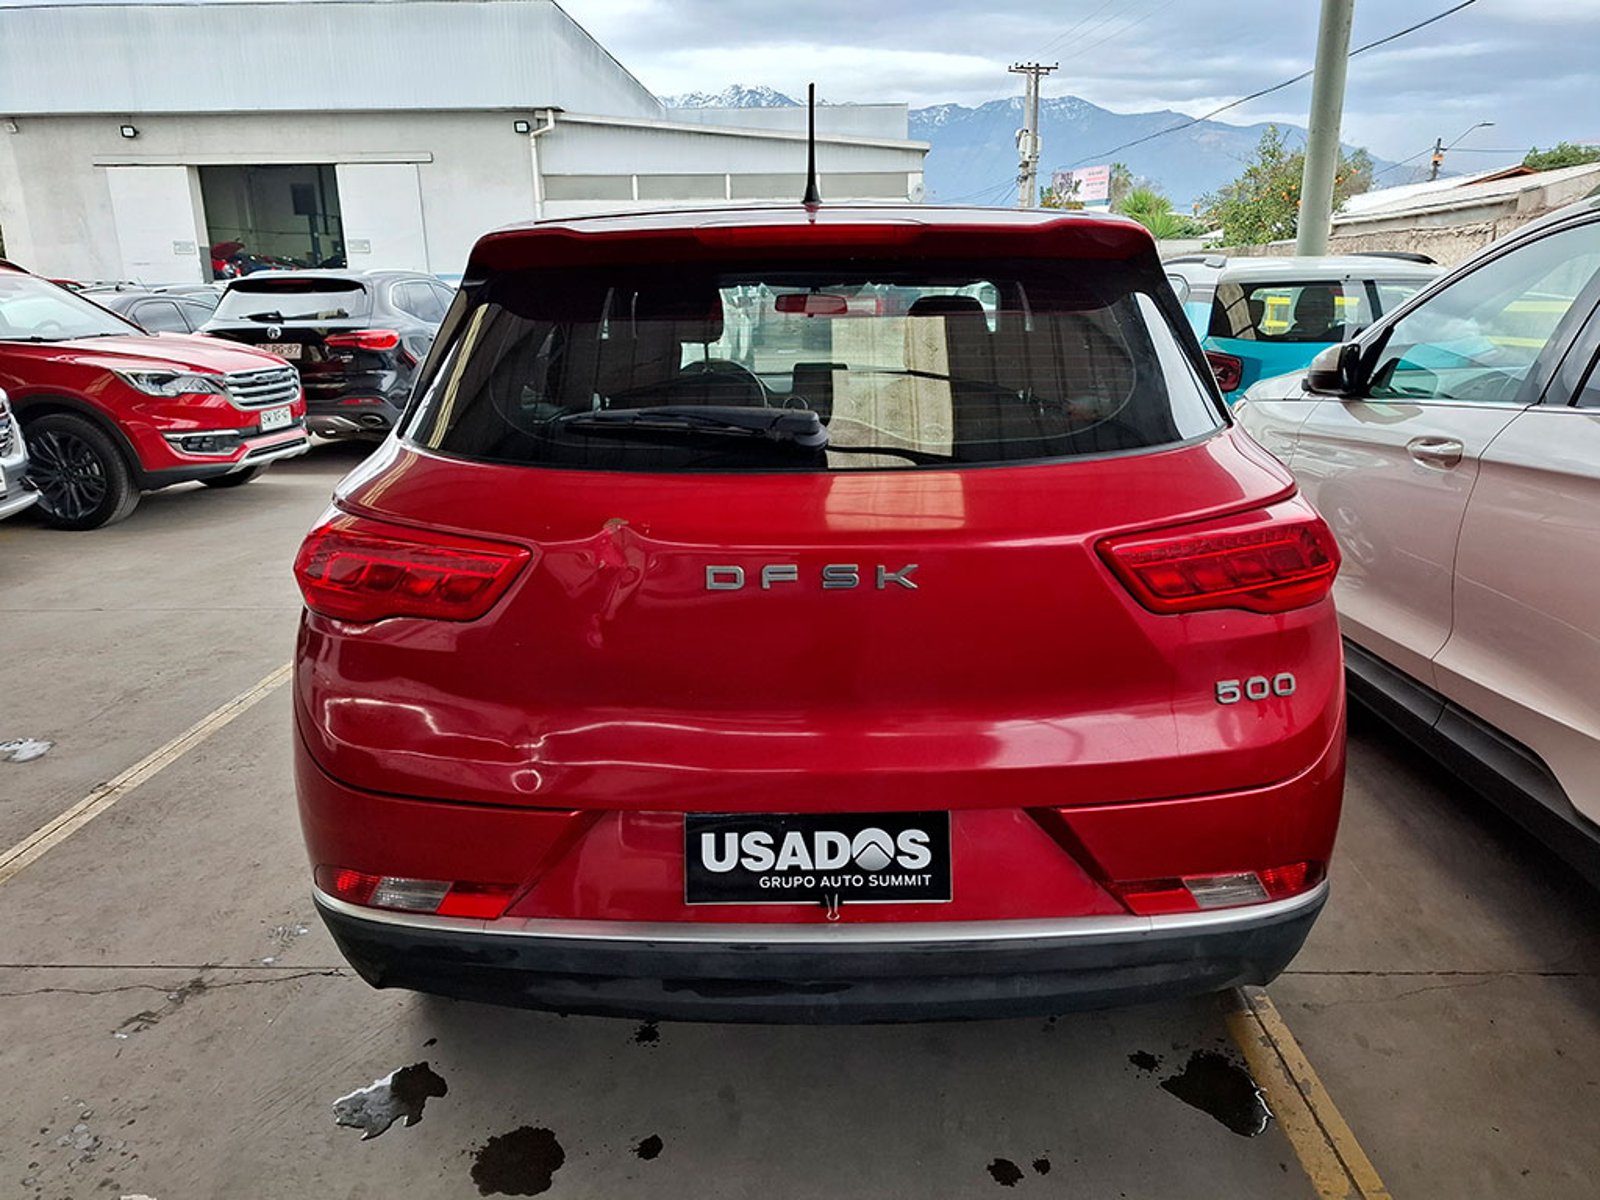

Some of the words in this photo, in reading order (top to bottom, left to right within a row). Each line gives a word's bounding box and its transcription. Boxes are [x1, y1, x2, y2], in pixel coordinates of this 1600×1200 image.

[705, 564, 918, 590] DFSK
[1215, 672, 1296, 704] 500
[701, 827, 932, 873] USADOS
[759, 876, 815, 889] GRUPO
[820, 875, 864, 888] AUTO
[868, 874, 932, 887] SUMMIT
